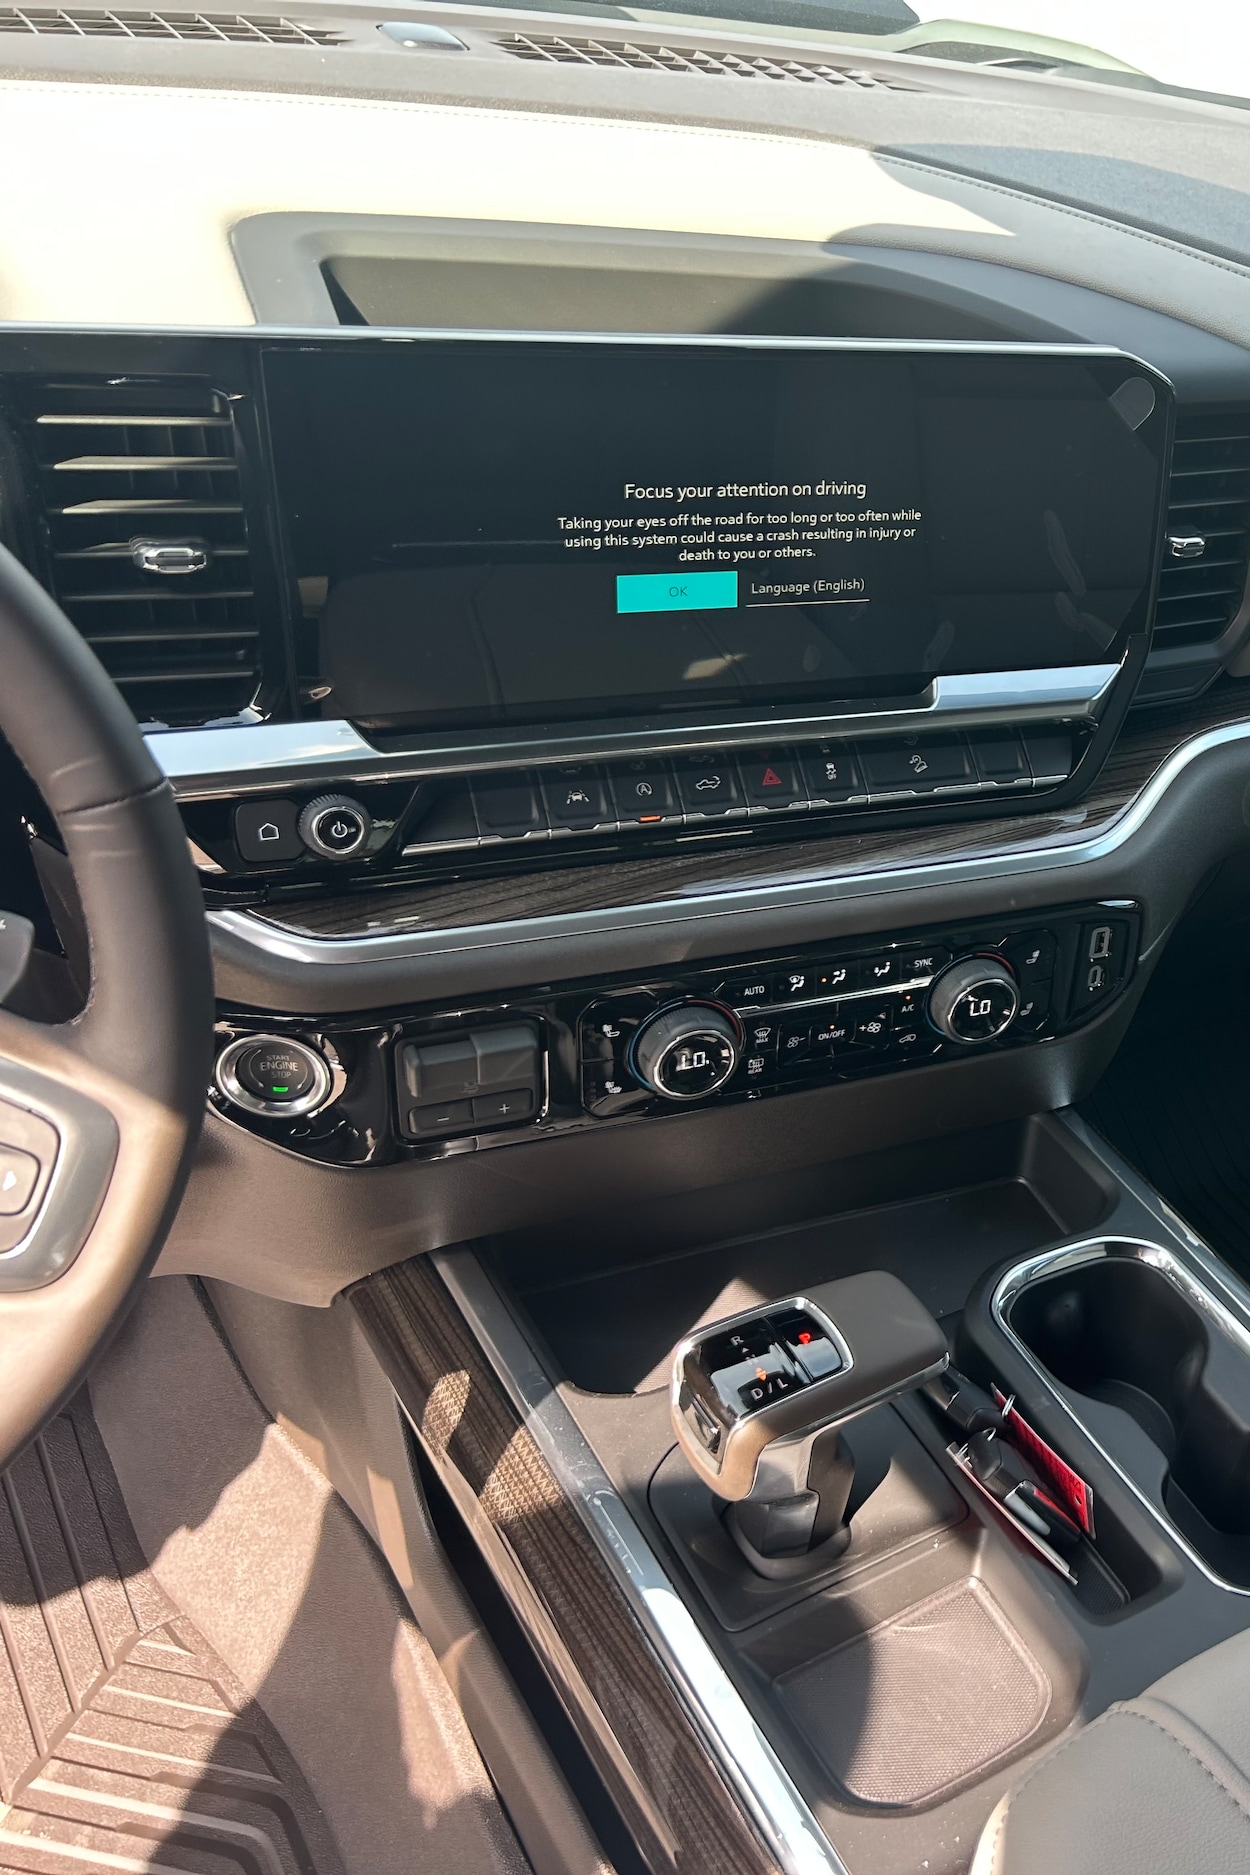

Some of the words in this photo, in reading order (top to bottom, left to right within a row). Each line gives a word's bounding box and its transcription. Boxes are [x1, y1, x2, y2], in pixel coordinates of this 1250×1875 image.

[624, 484, 674, 499] Focus
[677, 486, 713, 502] your
[717, 482, 788, 497] attention
[792, 484, 812, 496] on
[816, 480, 866, 500] driving
[558, 517, 602, 532] Taking
[604, 518, 634, 531] your
[636, 518, 666, 530] eyes
[669, 514, 689, 526] off
[691, 514, 712, 526] the
[716, 512, 743, 525] road
[746, 512, 764, 524] for
[767, 514, 788, 524] too
[790, 512, 817, 526] long
[820, 512, 832, 522] or
[836, 512, 856, 522] too
[858, 510, 889, 522] often
[892, 509, 922, 521] while
[565, 536, 602, 550] using
[604, 534, 629, 546] this
[632, 534, 677, 548] system
[680, 531, 715, 544] could
[718, 532, 753, 542] cause
[756, 532, 764, 542] a
[766, 528, 799, 541] crash
[802, 528, 853, 542] resulting
[856, 528, 866, 538] in
[869, 527, 901, 540] injury
[903, 528, 916, 538] or
[679, 548, 714, 562] death
[718, 550, 731, 560] to
[732, 549, 756, 562] you
[758, 549, 771, 558] or
[774, 546, 816, 558] others.
[669, 586, 688, 598] OK
[751, 582, 810, 596] Language
[813, 578, 865, 594] (English)
[914, 958, 934, 968] SYNC
[744, 986, 765, 996] AUTO
[901, 1004, 914, 1013] A/C
[818, 1030, 846, 1040] ON/OFF
[260, 1060, 298, 1071] ENGINE
[730, 1336, 744, 1346] R
[798, 1332, 811, 1346] P
